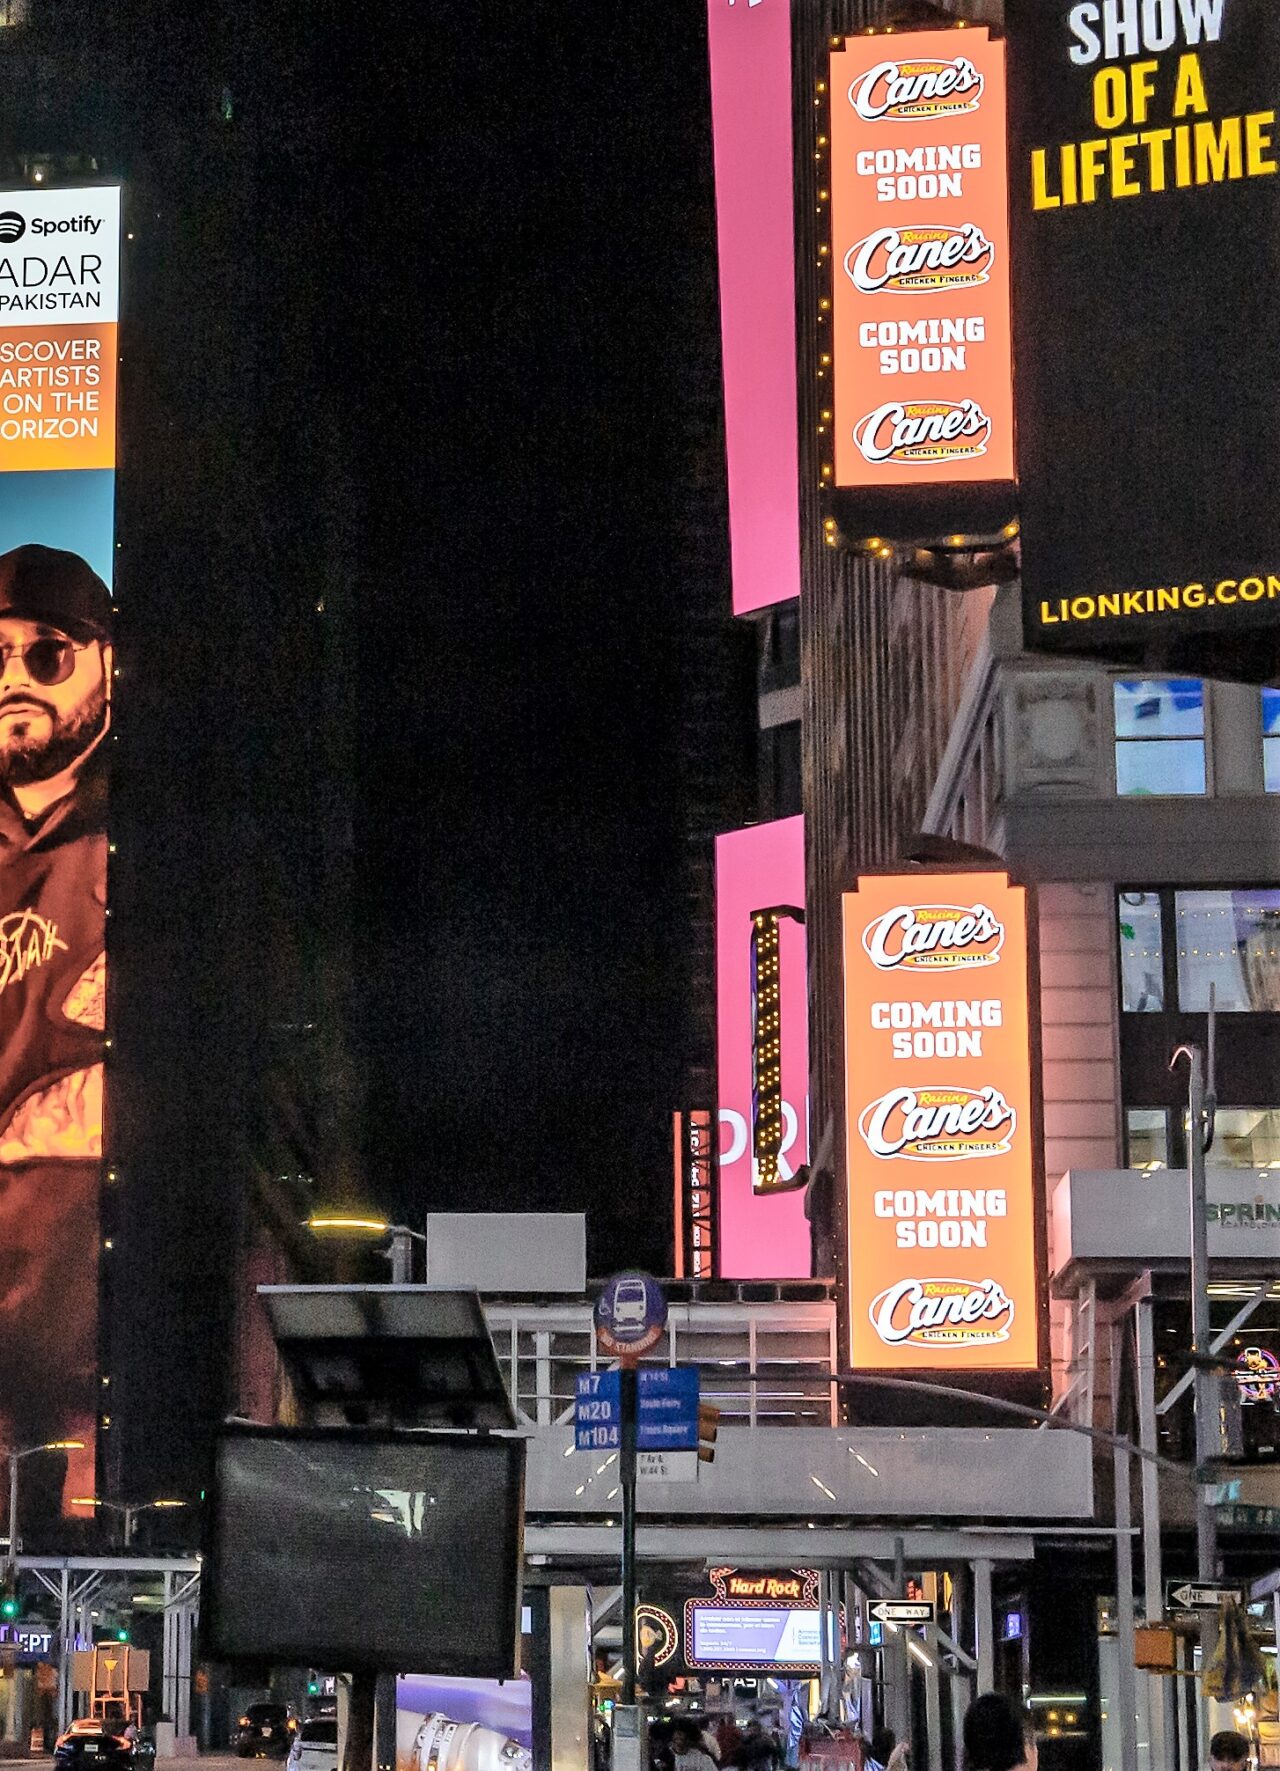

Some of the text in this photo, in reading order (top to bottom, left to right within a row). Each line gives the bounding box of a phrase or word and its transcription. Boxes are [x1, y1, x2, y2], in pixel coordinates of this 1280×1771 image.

[1069, 0, 1224, 65] SHOW
[901, 64, 943, 76] Raising
[856, 57, 981, 119] Cane's
[1093, 52, 1209, 129] OF A
[856, 144, 982, 175] COMING
[1030, 110, 1278, 210] LIFETIME
[876, 173, 963, 202] SOON
[30, 215, 102, 236] Spotify
[902, 231, 949, 243] Raising
[851, 223, 993, 291] Cane's
[859, 316, 985, 348] COMING
[879, 346, 966, 375] SOON
[3, 391, 100, 414] ON THE
[906, 406, 951, 416] Raising
[861, 399, 989, 461] Cane's
[917, 910, 960, 921] Raising
[870, 903, 1001, 967] Cane's
[871, 999, 1003, 1029] COMING
[891, 1030, 983, 1059] SOON
[920, 1092, 968, 1105] Raising
[867, 1086, 1012, 1155] Cane's
[874, 1189, 1007, 1218] COMING
[895, 1220, 988, 1249] SOON
[925, 1283, 970, 1295] Raising
[877, 1279, 1011, 1342] Cane's
[579, 1375, 601, 1394] M7
[578, 1401, 611, 1420] M20
[578, 1426, 619, 1446] M104
[730, 1578, 800, 1598] Hard Rock
[877, 1607, 925, 1616] ONE WAY
